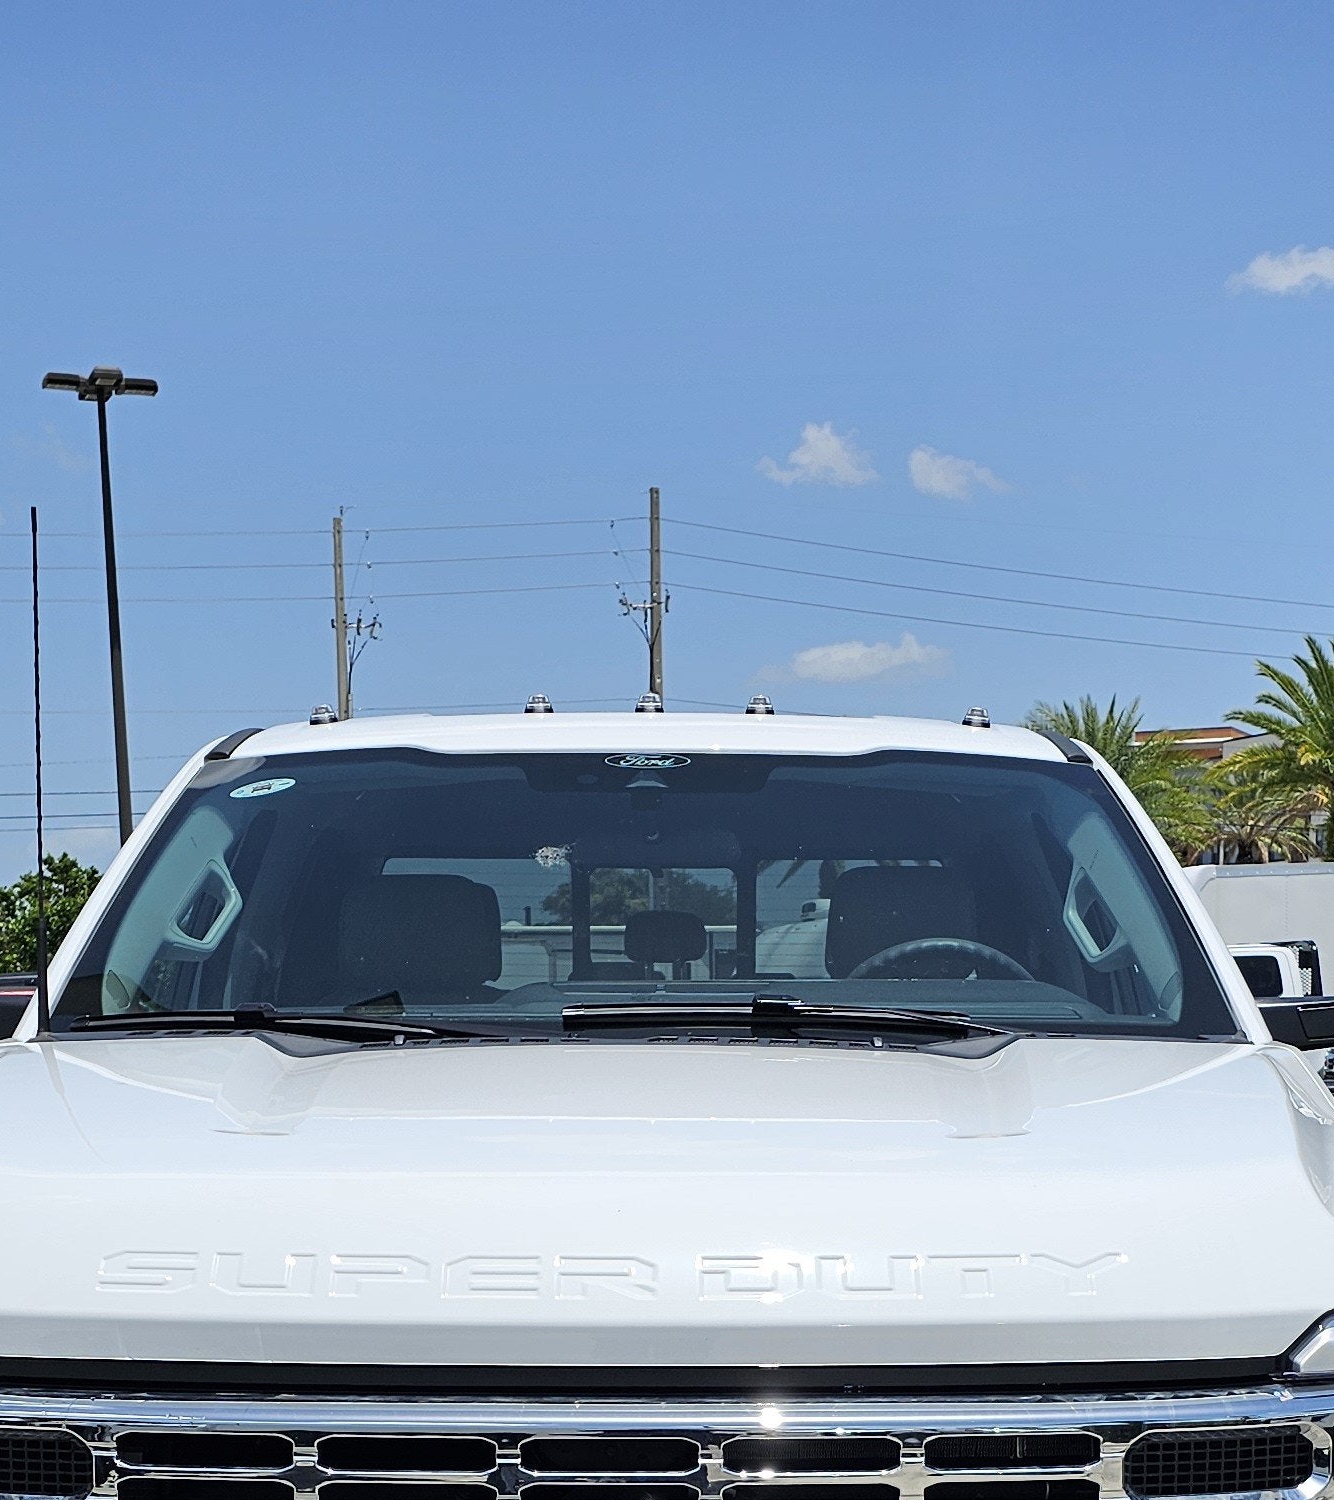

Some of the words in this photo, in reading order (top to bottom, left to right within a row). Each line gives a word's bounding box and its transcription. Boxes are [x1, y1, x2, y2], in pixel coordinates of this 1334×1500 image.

[620, 754, 675, 767] Ford
[95, 1249, 657, 1301] SUPER
[695, 1250, 1129, 1303] DUTY
